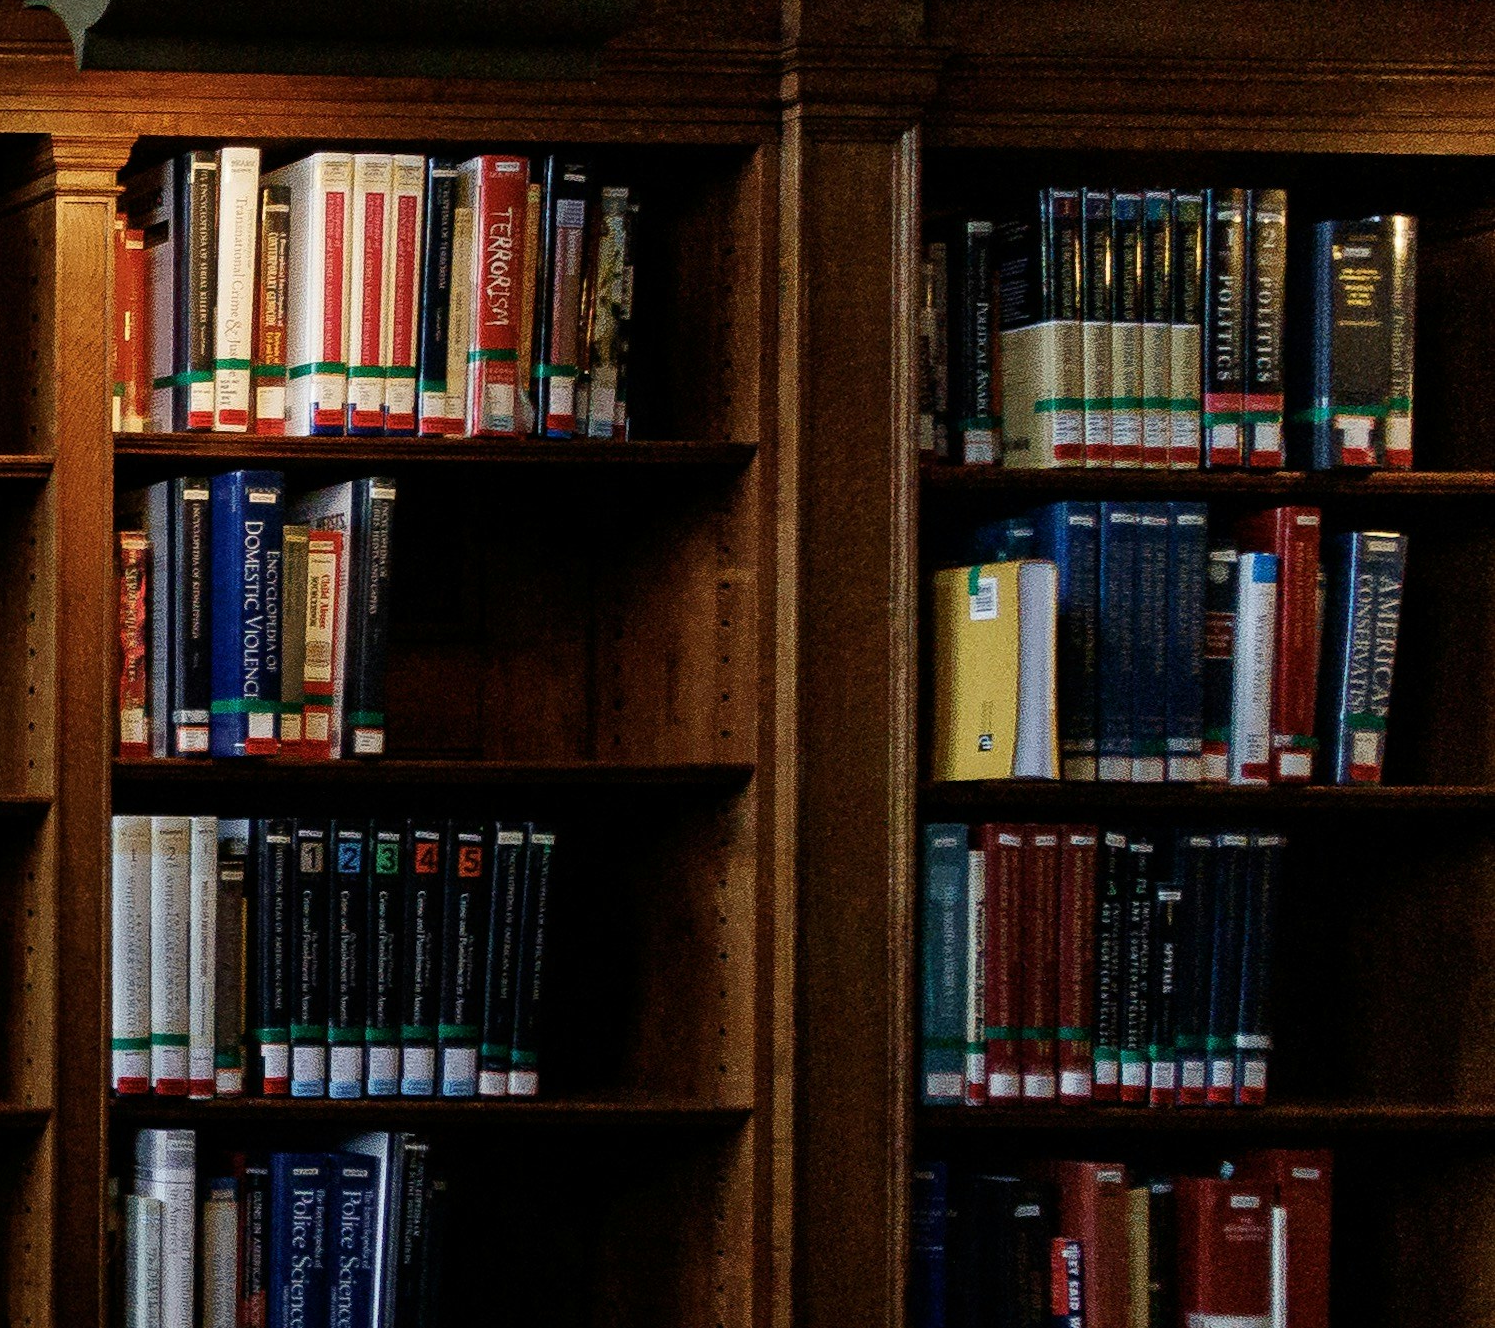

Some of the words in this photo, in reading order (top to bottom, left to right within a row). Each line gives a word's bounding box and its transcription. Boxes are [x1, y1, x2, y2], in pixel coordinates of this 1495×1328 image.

[486, 207, 514, 326] TERRORISM
[1216, 274, 1235, 381] POLITICS
[1255, 276, 1274, 384] POLITICS
[243, 521, 264, 611] DOMESTIC
[320, 574, 331, 601] Child
[265, 550, 281, 651] ENCYCLOPEDIA
[319, 603, 330, 629] Abuse
[242, 614, 264, 700] VIOLENCE
[265, 654, 278, 673] OF
[307, 847, 317, 870] 1
[342, 847, 359, 871] 2
[379, 847, 397, 872] 3
[419, 847, 436, 870] 4
[461, 848, 478, 873] 5
[292, 1189, 315, 1248] Police
[339, 1190, 363, 1249] Police
